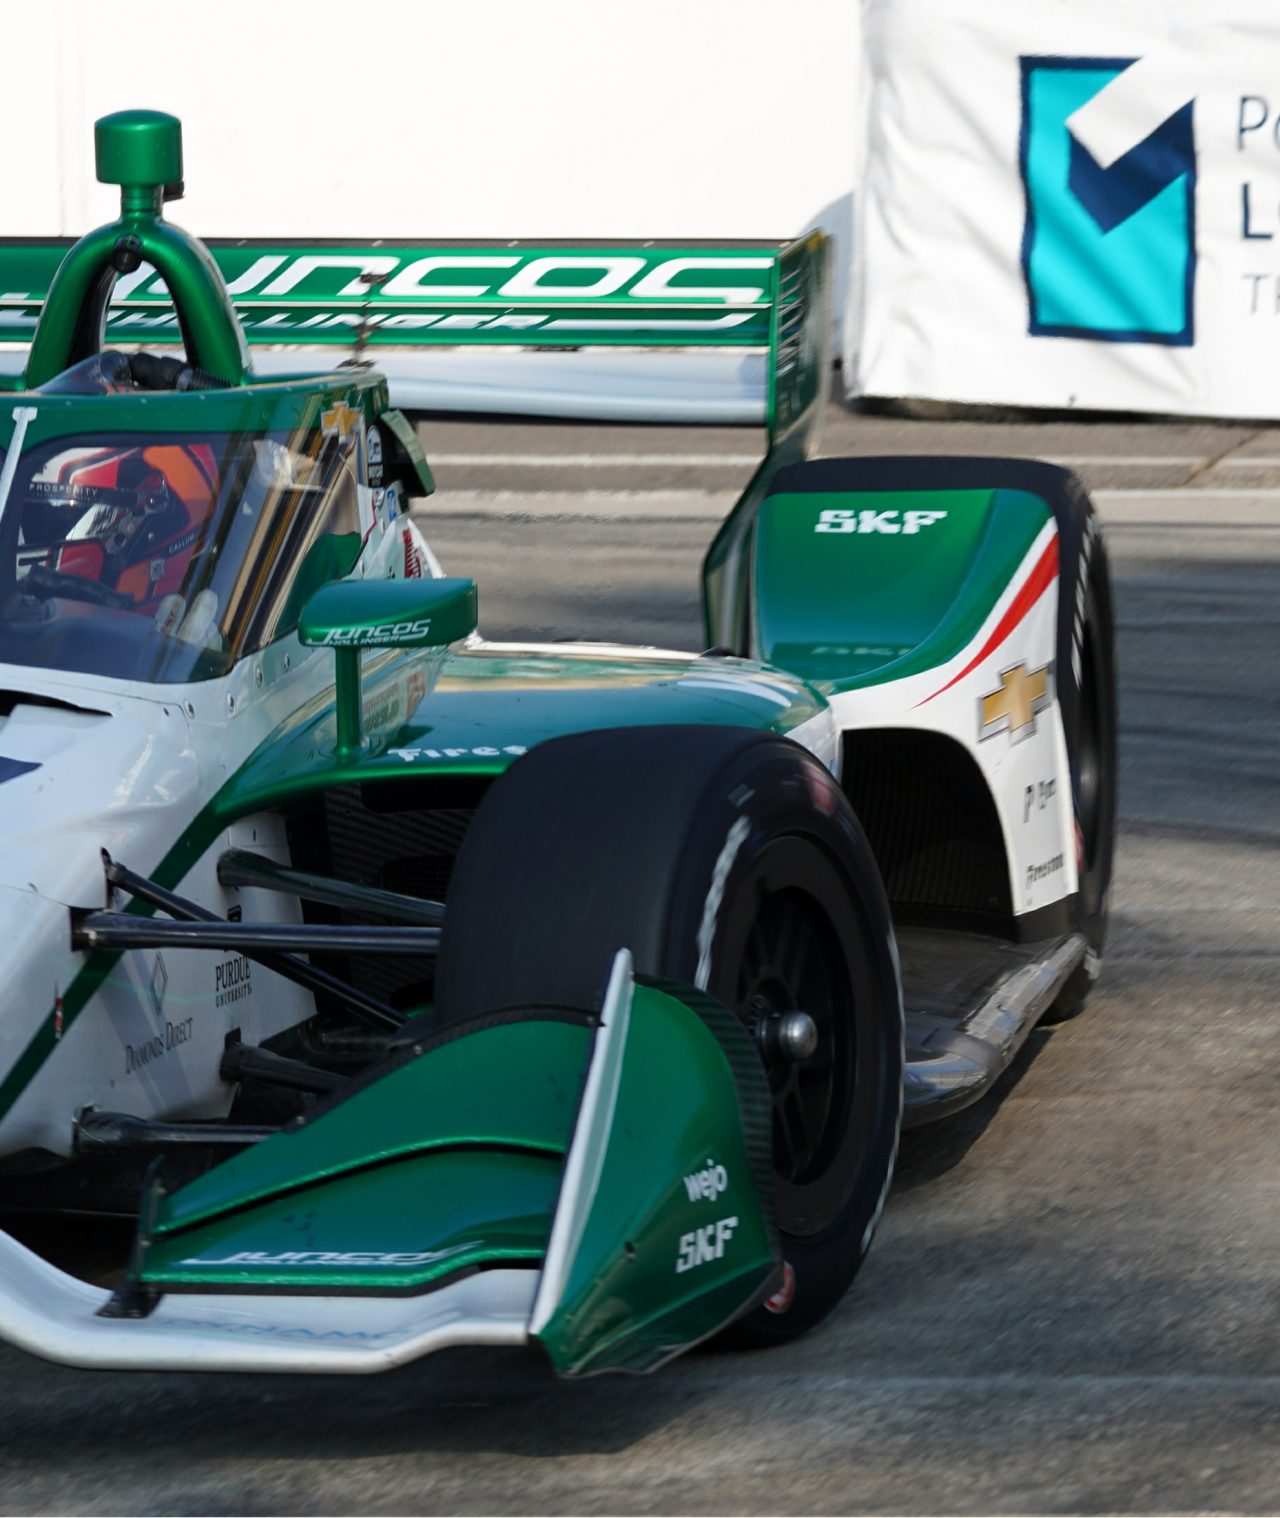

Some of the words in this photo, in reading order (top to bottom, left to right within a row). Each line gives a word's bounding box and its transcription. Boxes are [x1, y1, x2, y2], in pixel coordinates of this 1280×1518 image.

[1236, 95, 1280, 152] P
[1241, 272, 1280, 316] T
[28, 483, 98, 497] PROSPERITY
[814, 509, 948, 535] SKF
[328, 635, 400, 646] HOLLINGER
[215, 955, 252, 992] PURDUE
[215, 982, 253, 1009] UNIVERSITY
[683, 1158, 729, 1202] wejo
[675, 1216, 739, 1273] SKF
